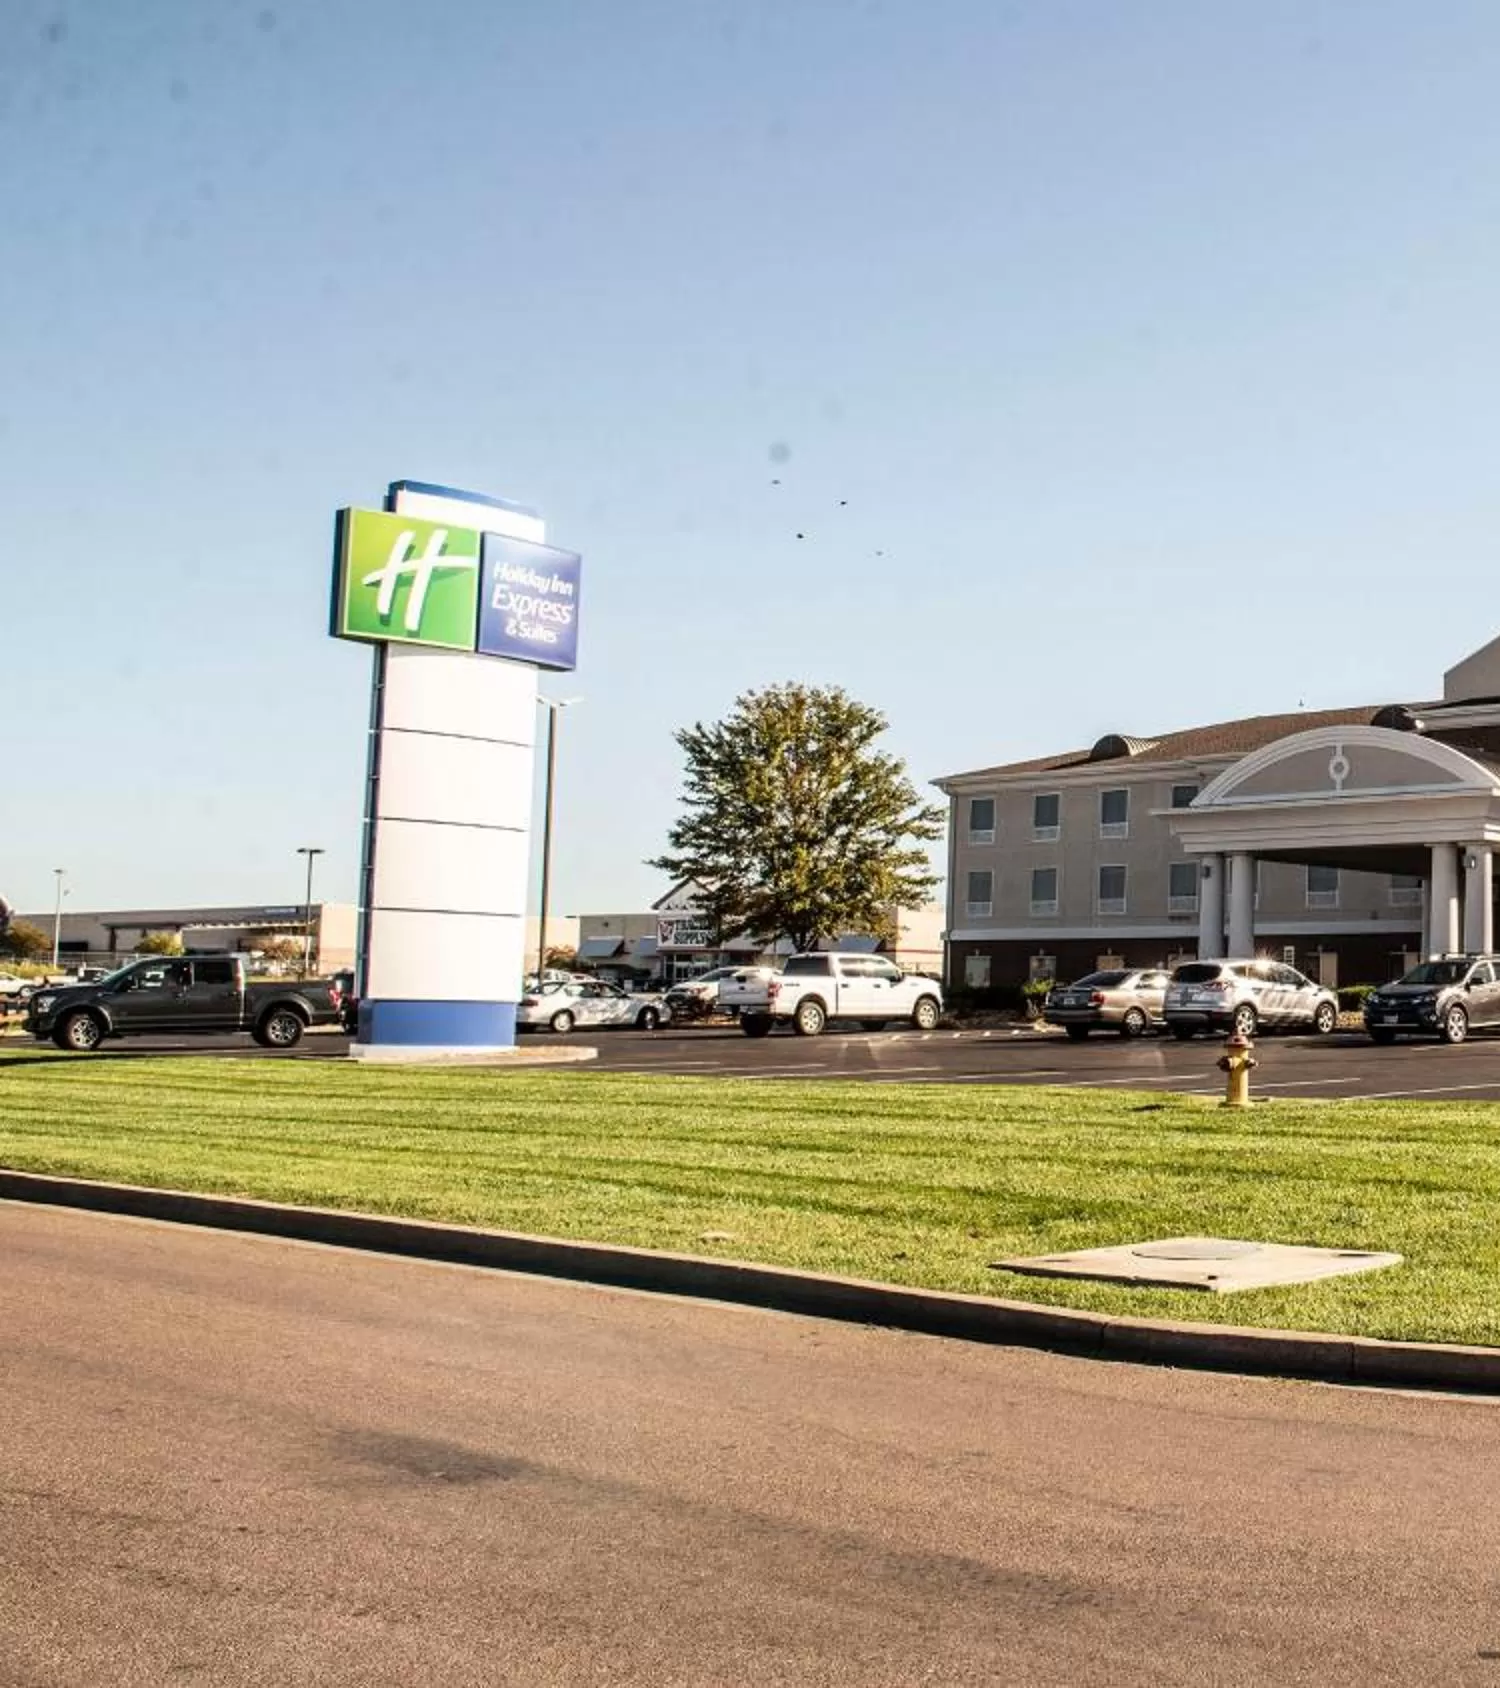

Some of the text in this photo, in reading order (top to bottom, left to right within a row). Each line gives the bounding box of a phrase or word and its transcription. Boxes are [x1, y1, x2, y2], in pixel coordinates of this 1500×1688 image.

[494, 562, 574, 596] Holiday Inn
[492, 584, 575, 625] Express
[518, 621, 558, 643] Suites
